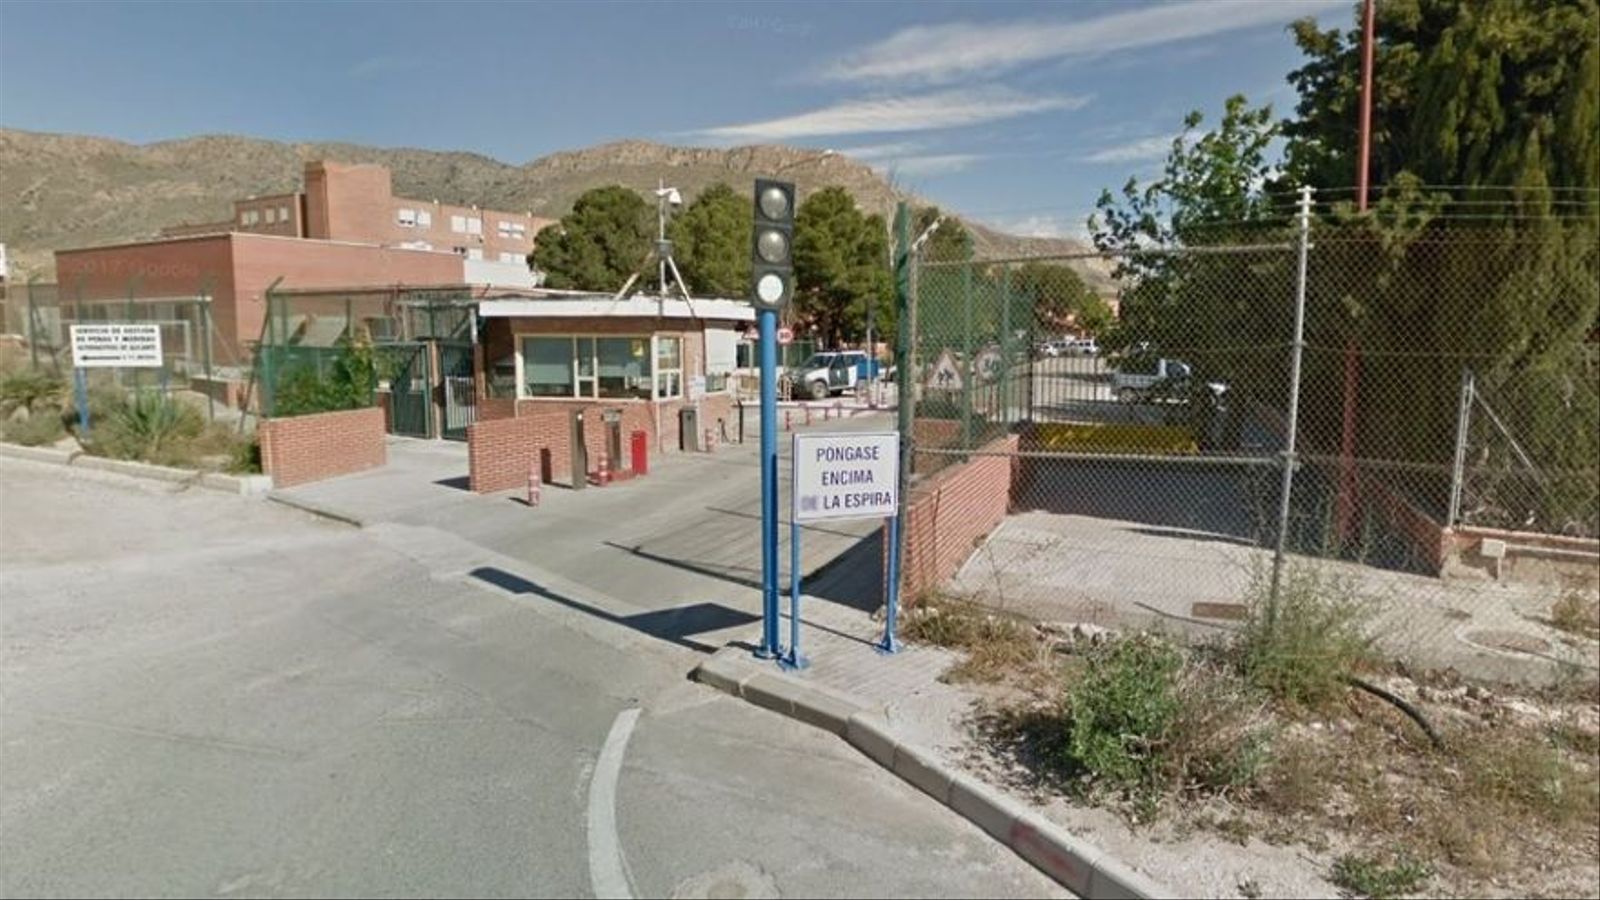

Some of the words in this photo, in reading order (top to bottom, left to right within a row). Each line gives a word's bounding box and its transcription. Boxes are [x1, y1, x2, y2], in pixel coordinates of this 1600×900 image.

[816, 446, 880, 462] PONGASE
[822, 469, 873, 486] ENCIMA
[823, 495, 841, 510] LA
[844, 491, 891, 509] ESPIRA
